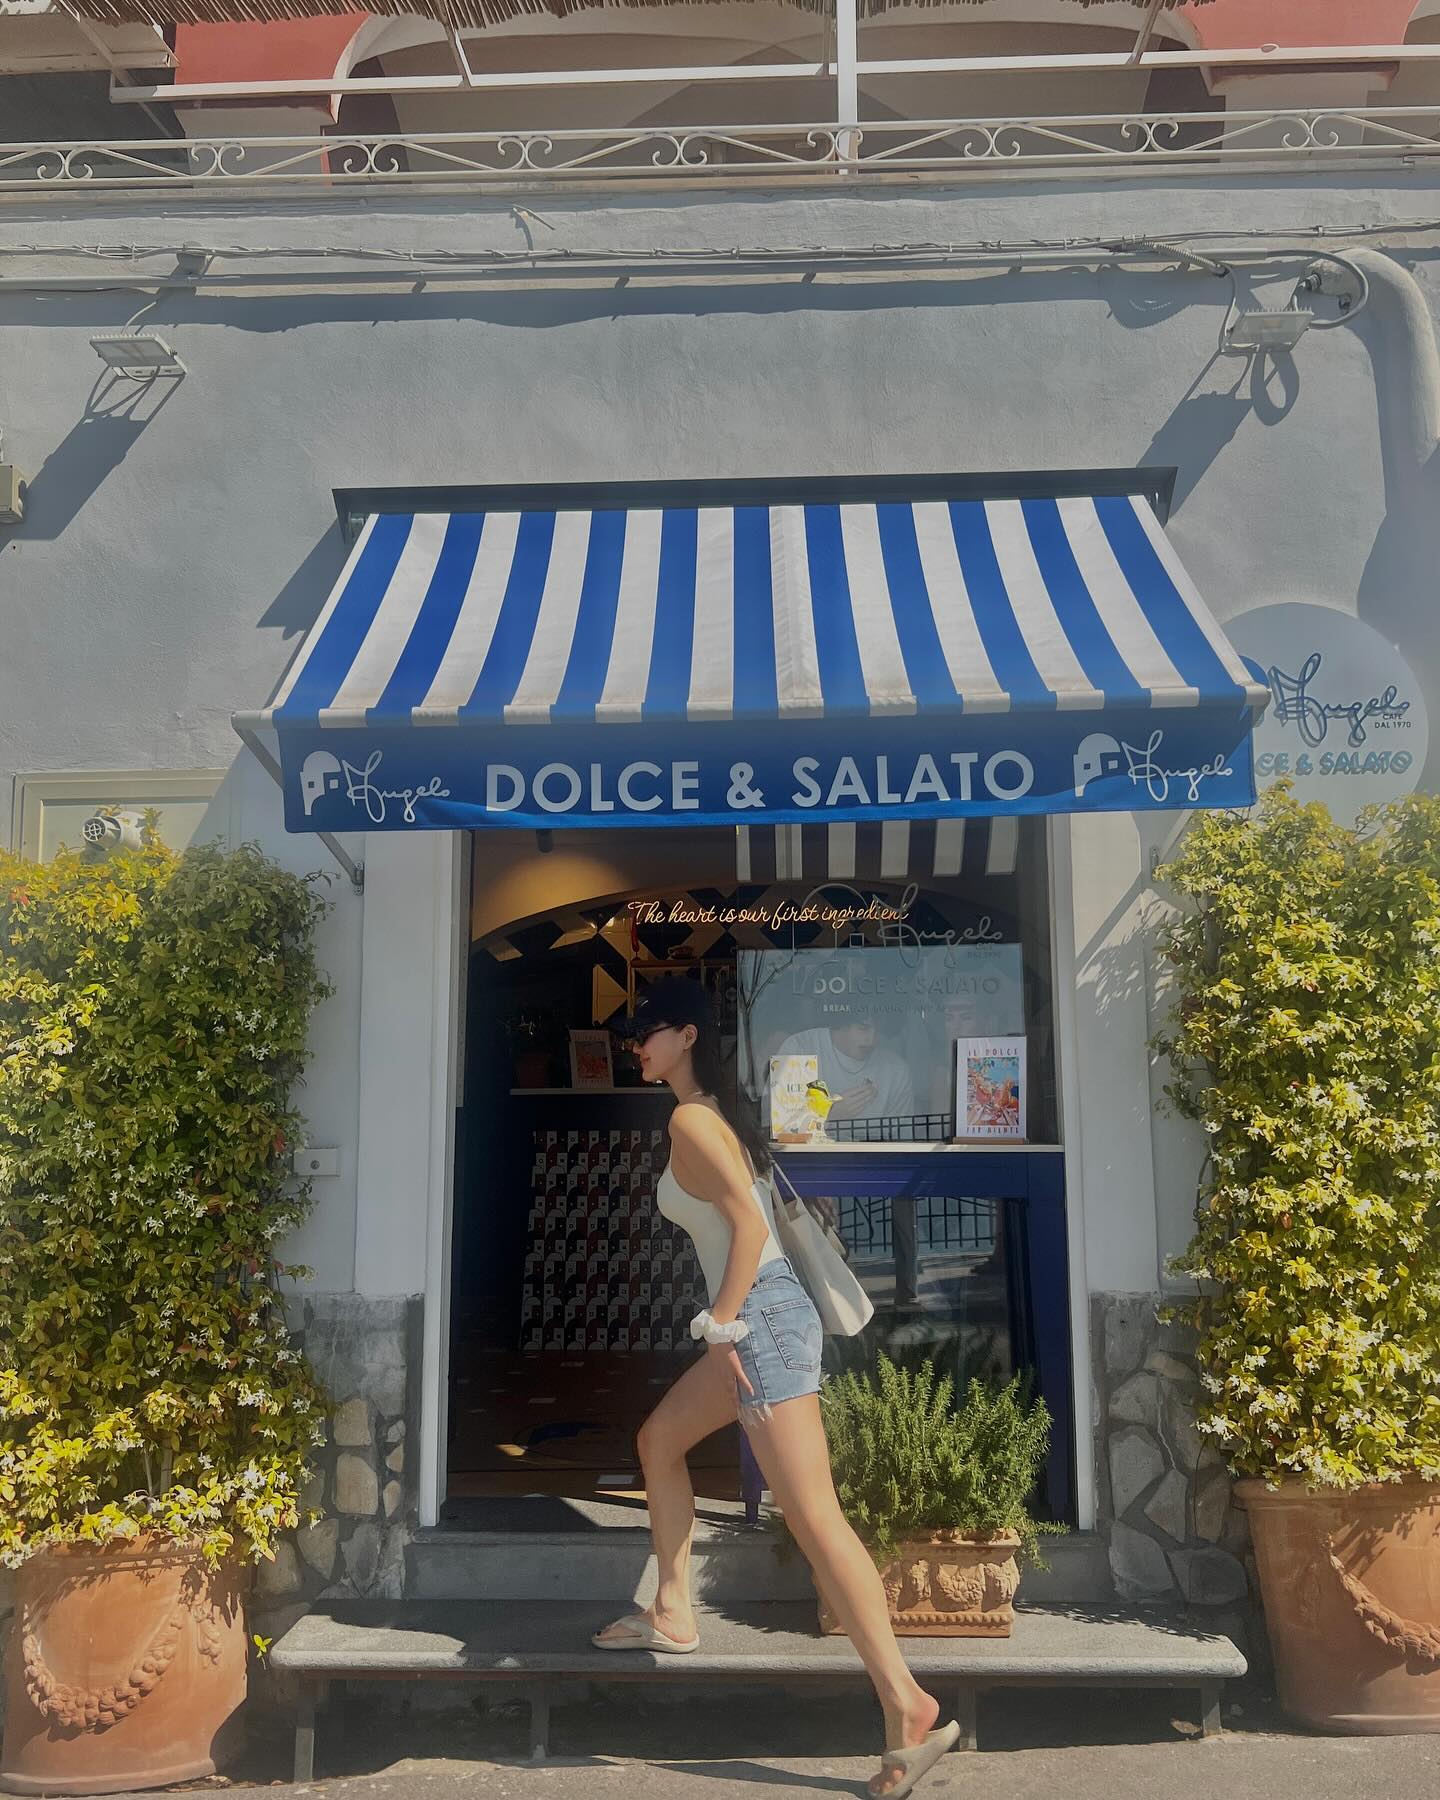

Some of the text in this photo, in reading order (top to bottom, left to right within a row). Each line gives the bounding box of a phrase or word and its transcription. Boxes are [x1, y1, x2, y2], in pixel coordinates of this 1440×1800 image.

[1266, 652, 1411, 747] Angelo
[1374, 721, 1412, 729] DAL 1970
[343, 749, 450, 823] Angelo
[485, 761, 700, 813] DOLCE
[726, 761, 767, 810] &
[791, 749, 1035, 808] SALATO
[1120, 729, 1234, 802] Angelo
[1295, 752, 1314, 776] &
[1319, 750, 1413, 776] SALATO
[627, 899, 910, 931] The heart is our first ingredient
[814, 976, 887, 995] DOLCE
[915, 975, 1000, 995] SALATO
